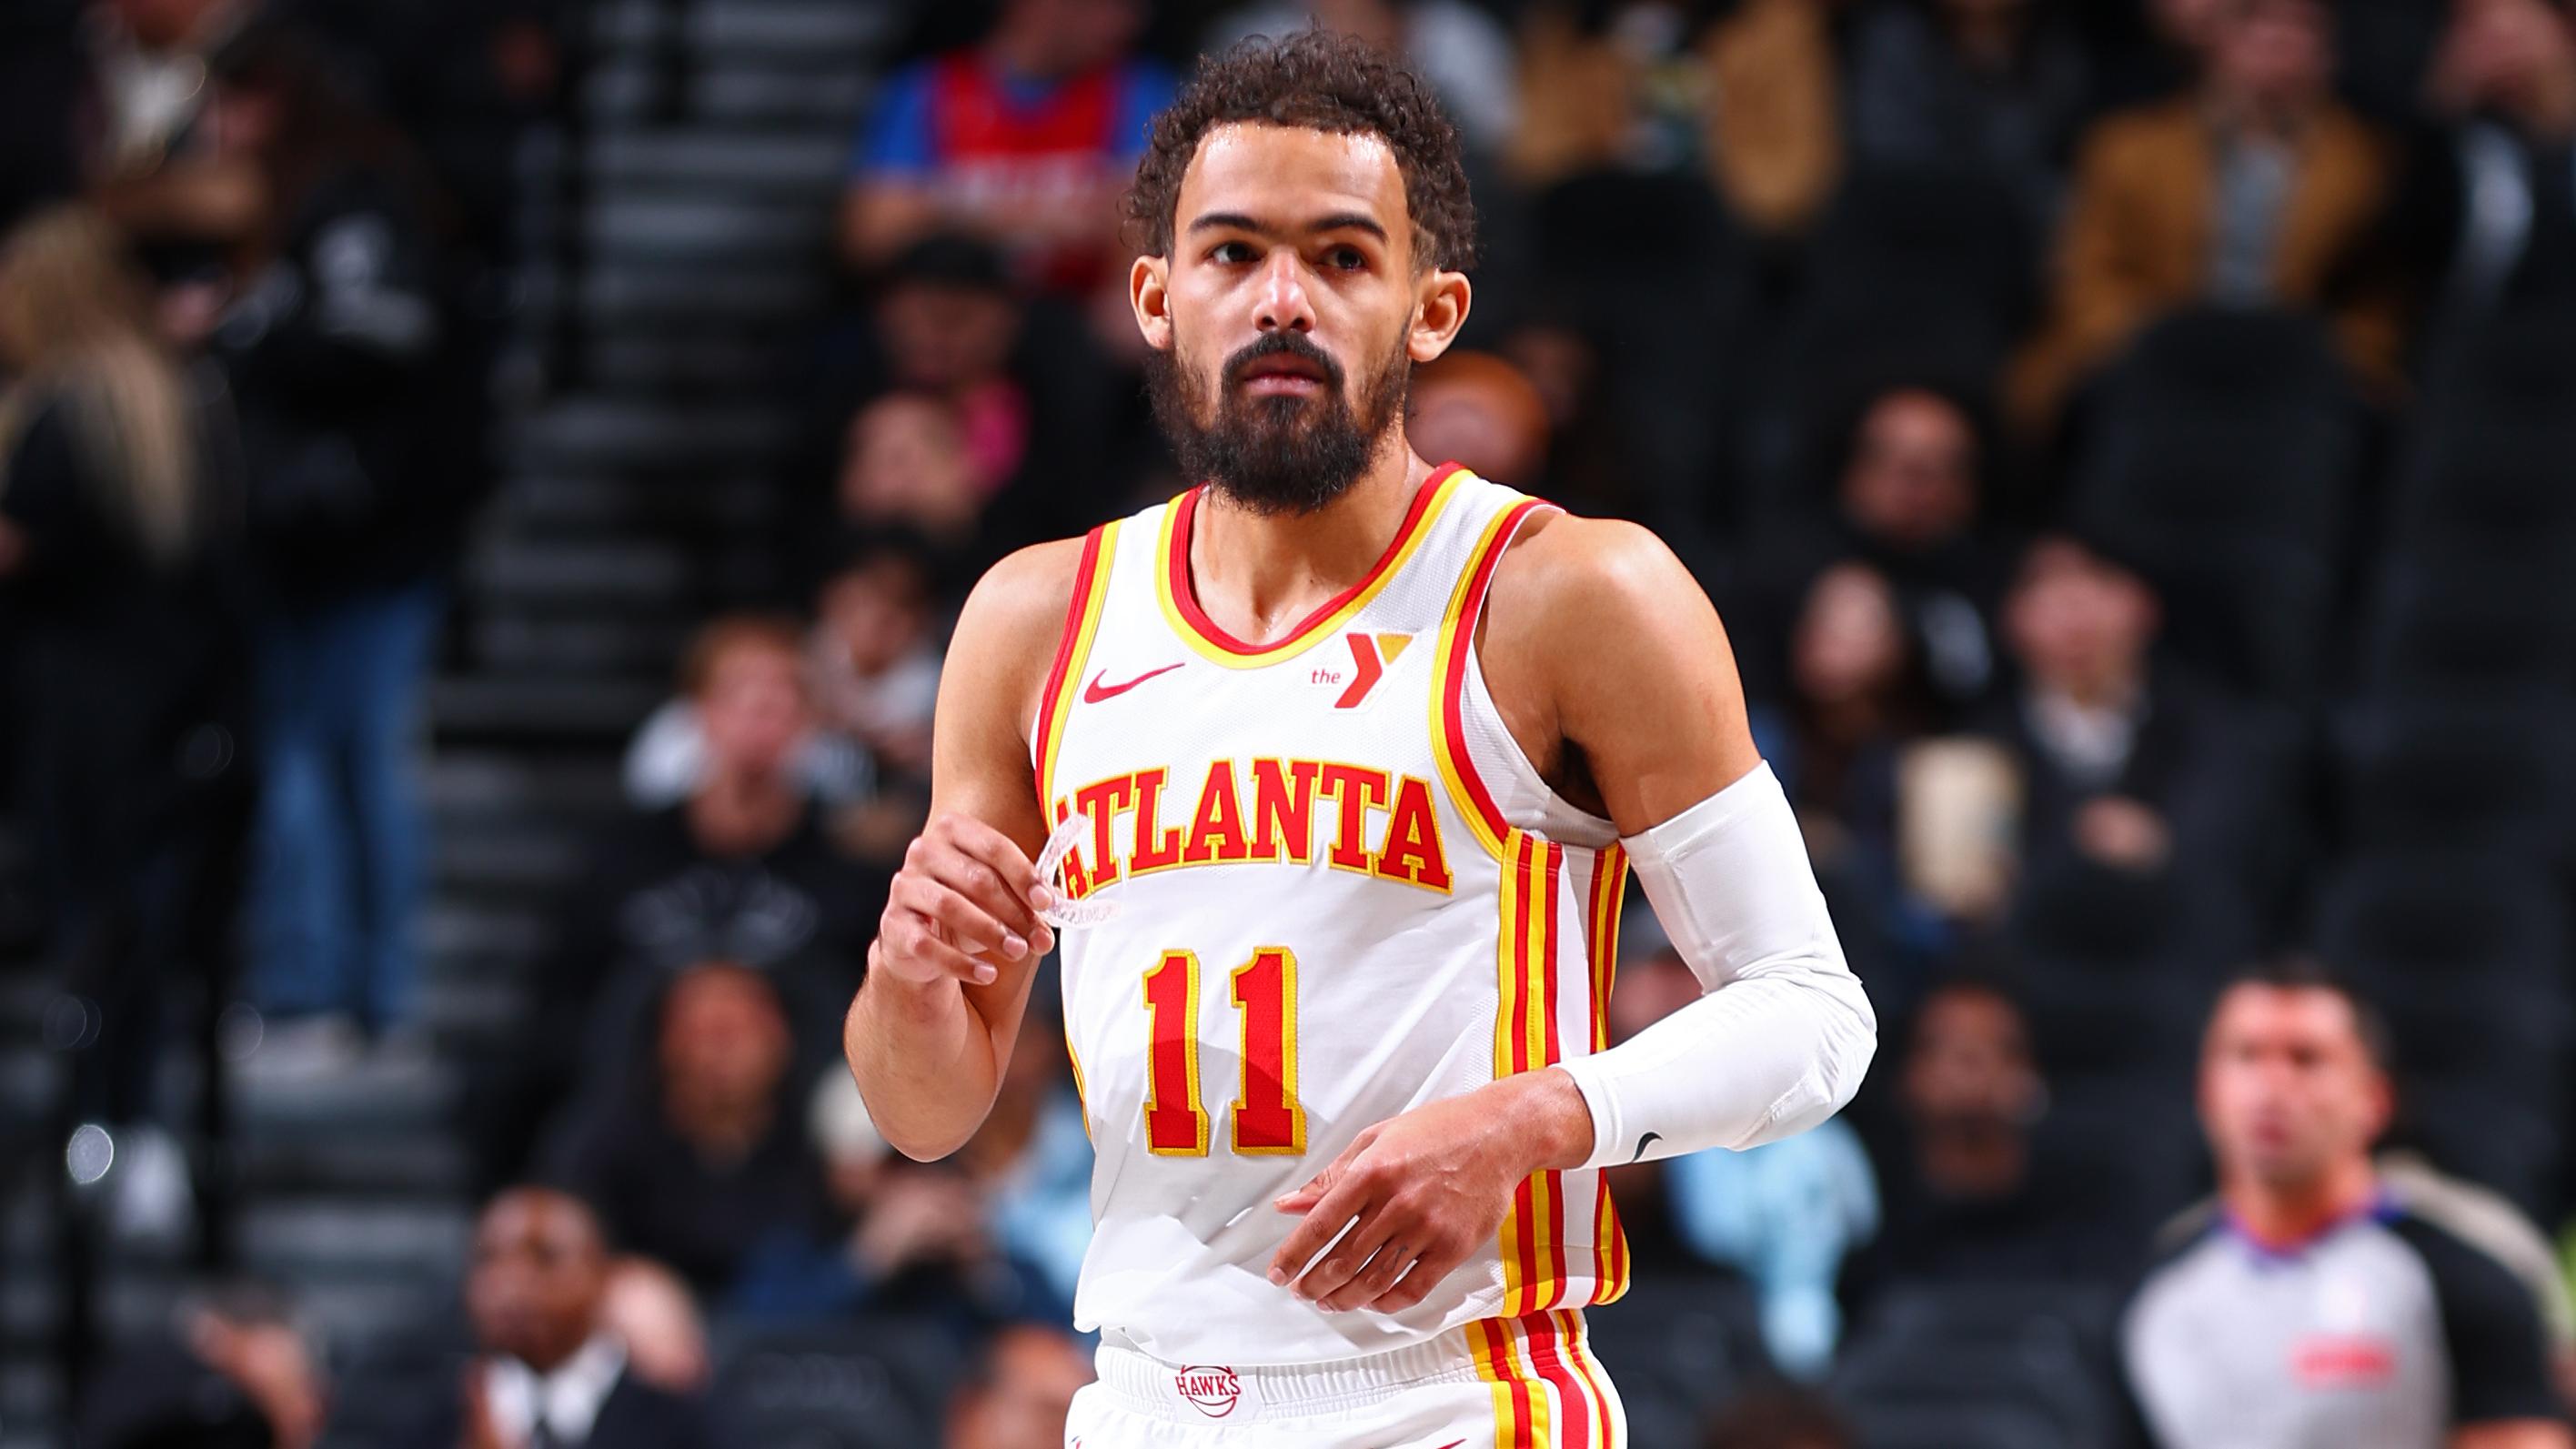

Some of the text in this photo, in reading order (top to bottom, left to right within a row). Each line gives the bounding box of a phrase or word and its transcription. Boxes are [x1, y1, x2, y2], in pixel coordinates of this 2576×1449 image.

[1312, 668, 1341, 684] the
[1142, 947, 1307, 1157] 11
[1175, 1374, 1241, 1396] HAWKS
